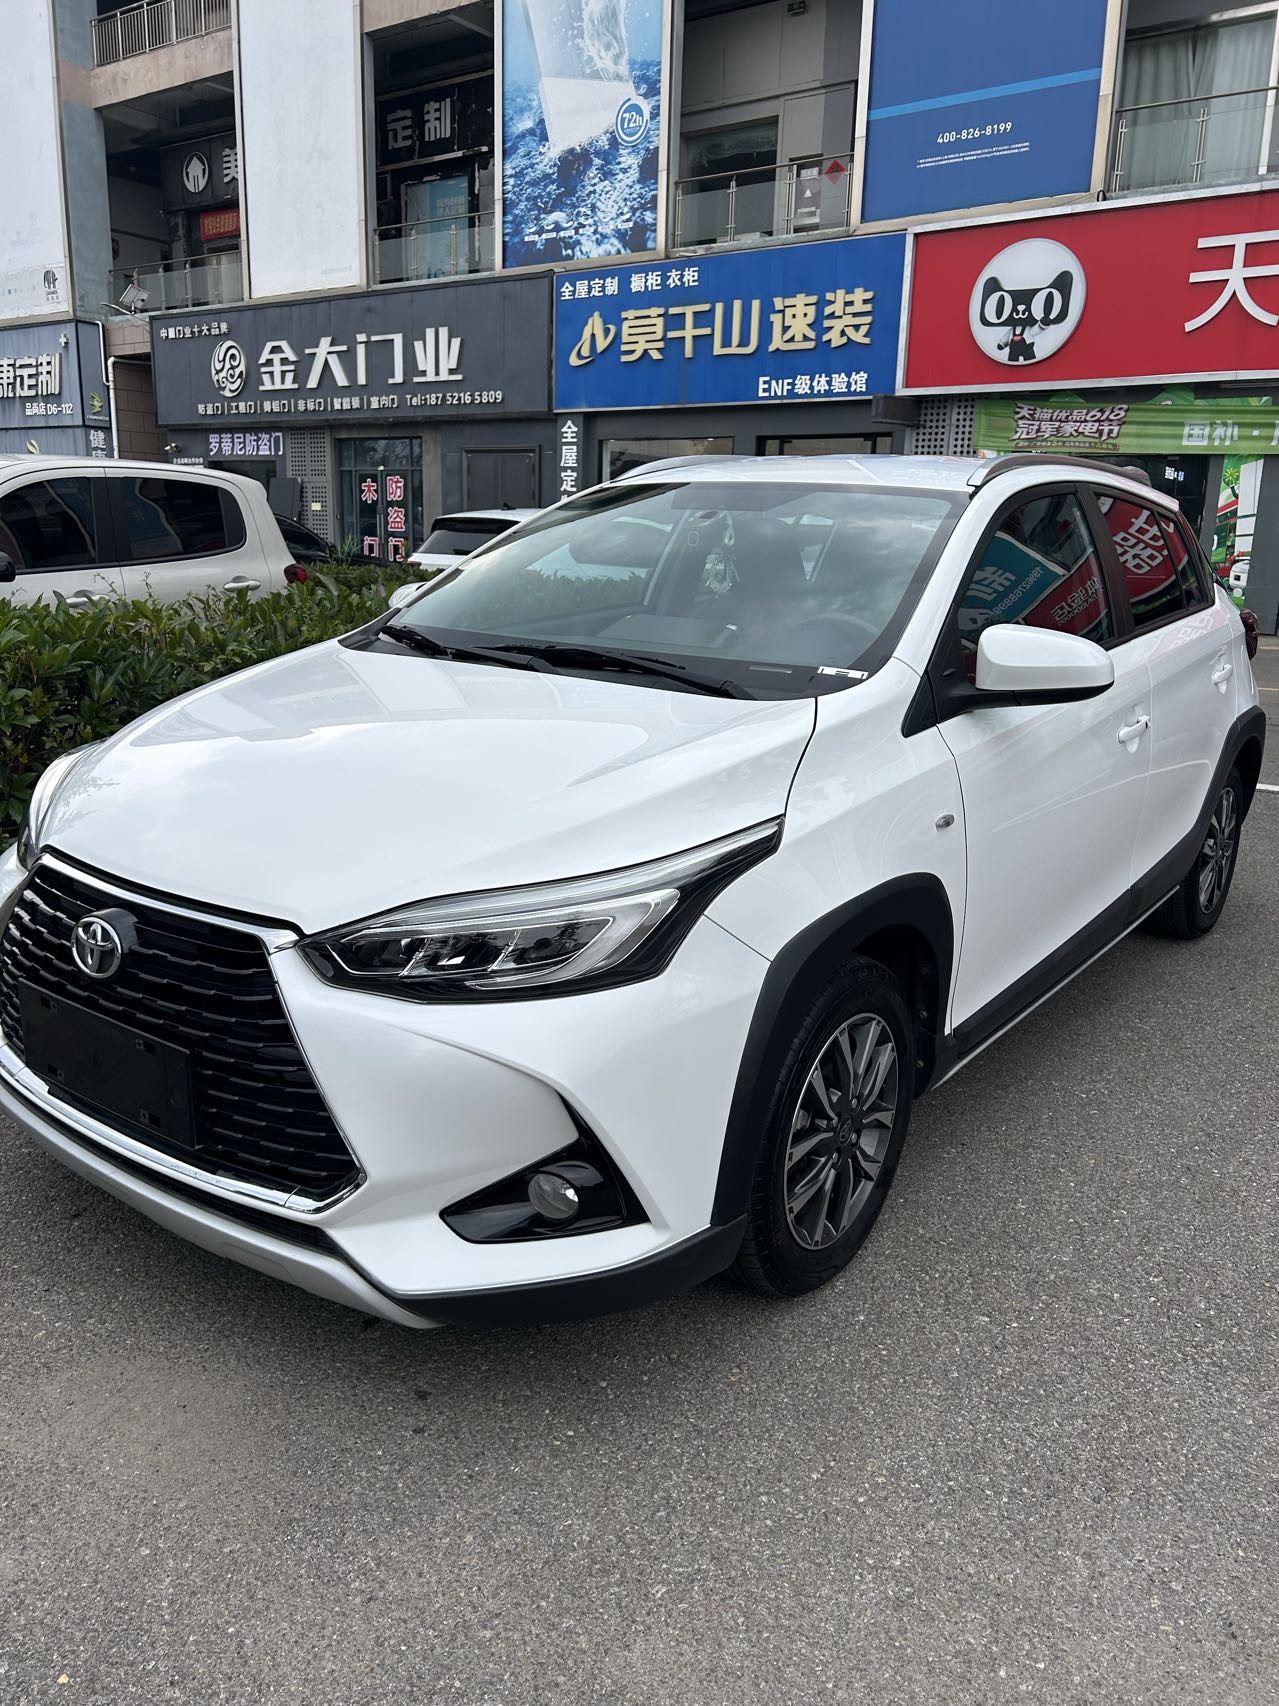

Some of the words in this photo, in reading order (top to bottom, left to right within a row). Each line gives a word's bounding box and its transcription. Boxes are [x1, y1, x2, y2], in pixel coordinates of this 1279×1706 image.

[387, 98, 451, 149] 定制
[623, 112, 642, 129] 72h
[937, 122, 1012, 143] 400-826-8199
[560, 277, 618, 300] 全屋定制
[630, 272, 662, 293] 橱柜
[666, 267, 699, 289] 衣柜
[1184, 229, 1279, 333] 天
[160, 322, 230, 340] 中国门业十大品牌
[620, 299, 760, 362] 莫干山
[768, 288, 874, 352] 速装
[258, 326, 464, 391] 金大门业
[230, 402, 255, 413] 工程门
[297, 399, 323, 411] 非标门
[370, 395, 398, 408] 室内门
[446, 392, 471, 405] 5216
[475, 391, 502, 403] 5809
[1014, 403, 1129, 421] 天猫优品618
[209, 432, 283, 456] 罗蒂尼防盗门
[1010, 420, 1124, 441] 冠军家电节
[560, 420, 578, 499] 全屋定
[387, 475, 406, 561] 防盗门
